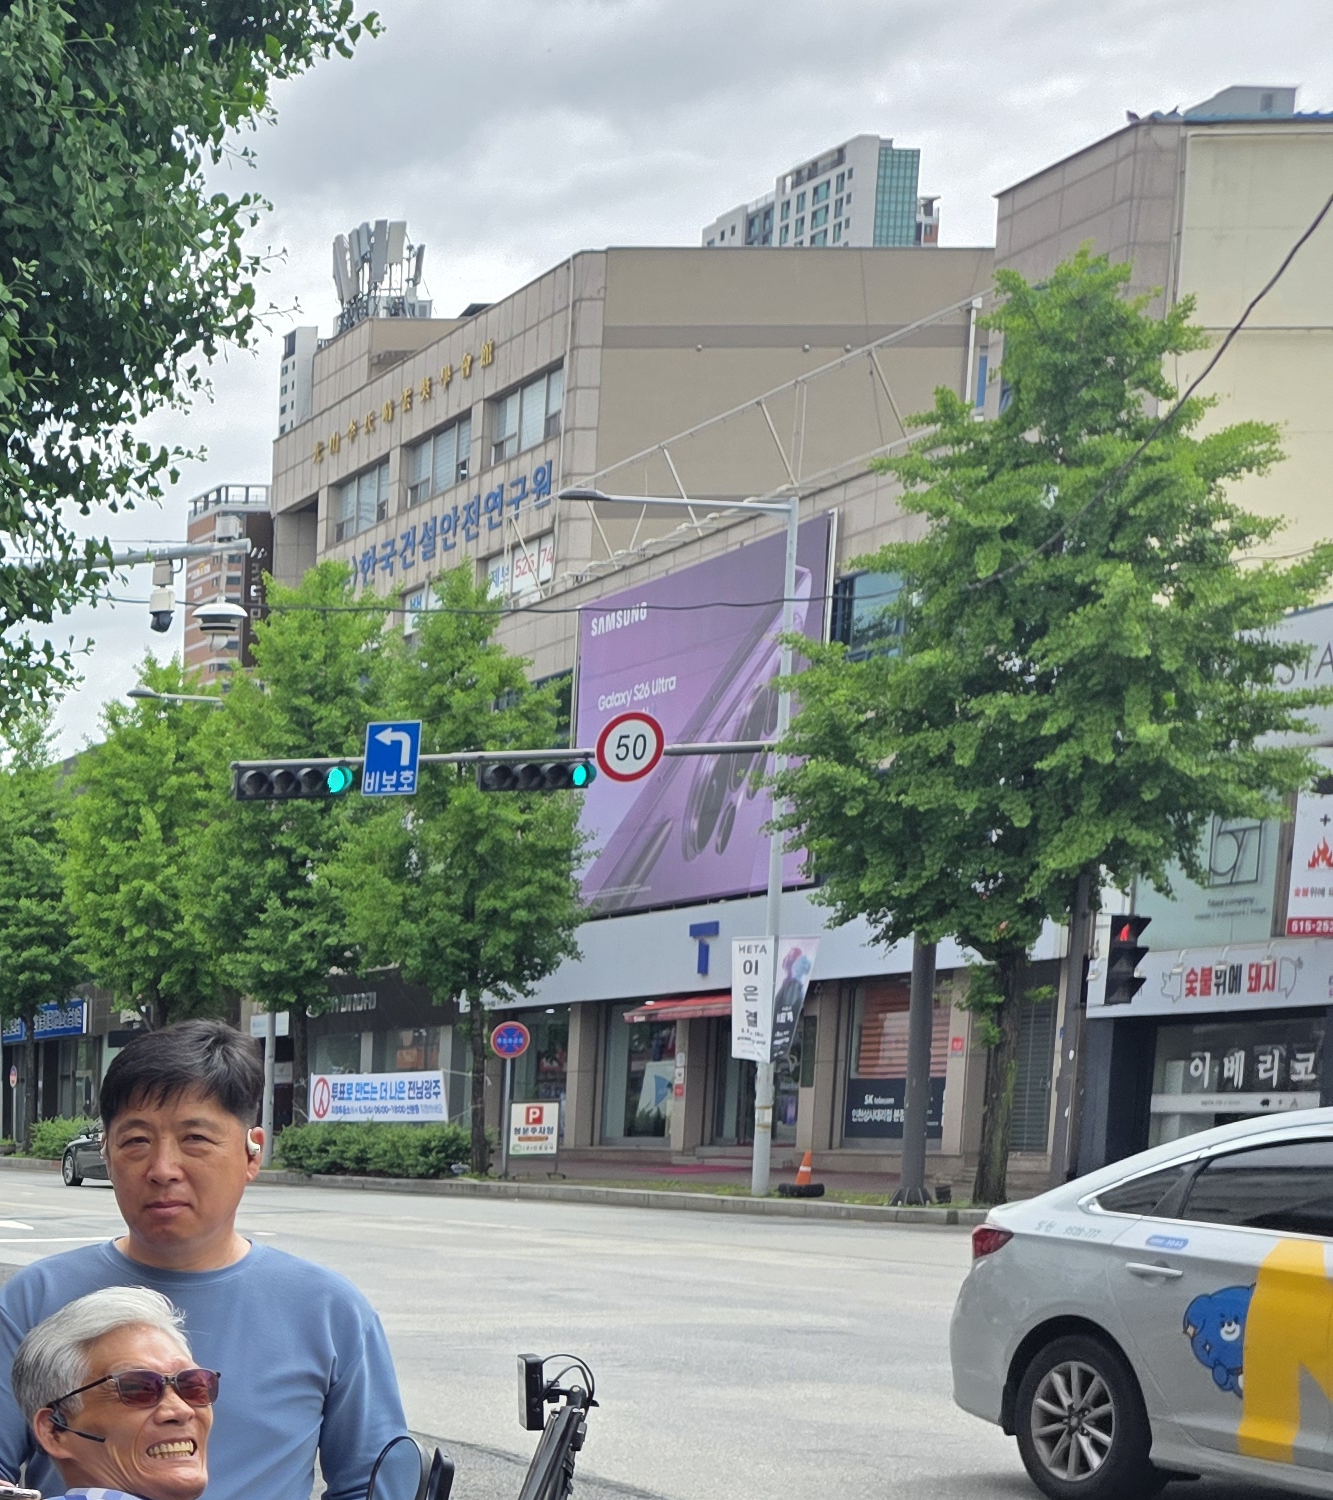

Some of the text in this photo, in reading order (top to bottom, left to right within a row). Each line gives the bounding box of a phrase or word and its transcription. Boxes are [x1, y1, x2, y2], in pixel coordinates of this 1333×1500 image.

[345, 460, 553, 587] )한국건설안전연구원
[591, 601, 648, 637] SAMSUNG
[598, 689, 633, 712] Galaxy
[633, 681, 650, 702] S26
[651, 675, 677, 697] Ultra
[615, 733, 647, 761] 50
[363, 769, 416, 795] 비보호
[1185, 960, 1277, 998] 숯불위에 돼지
[1189, 1049, 1317, 1090] 이베리코
[330, 1079, 441, 1102] 투표로 만드는 더 나은 전남광주
[864, 1093, 895, 1105] SK telecom
